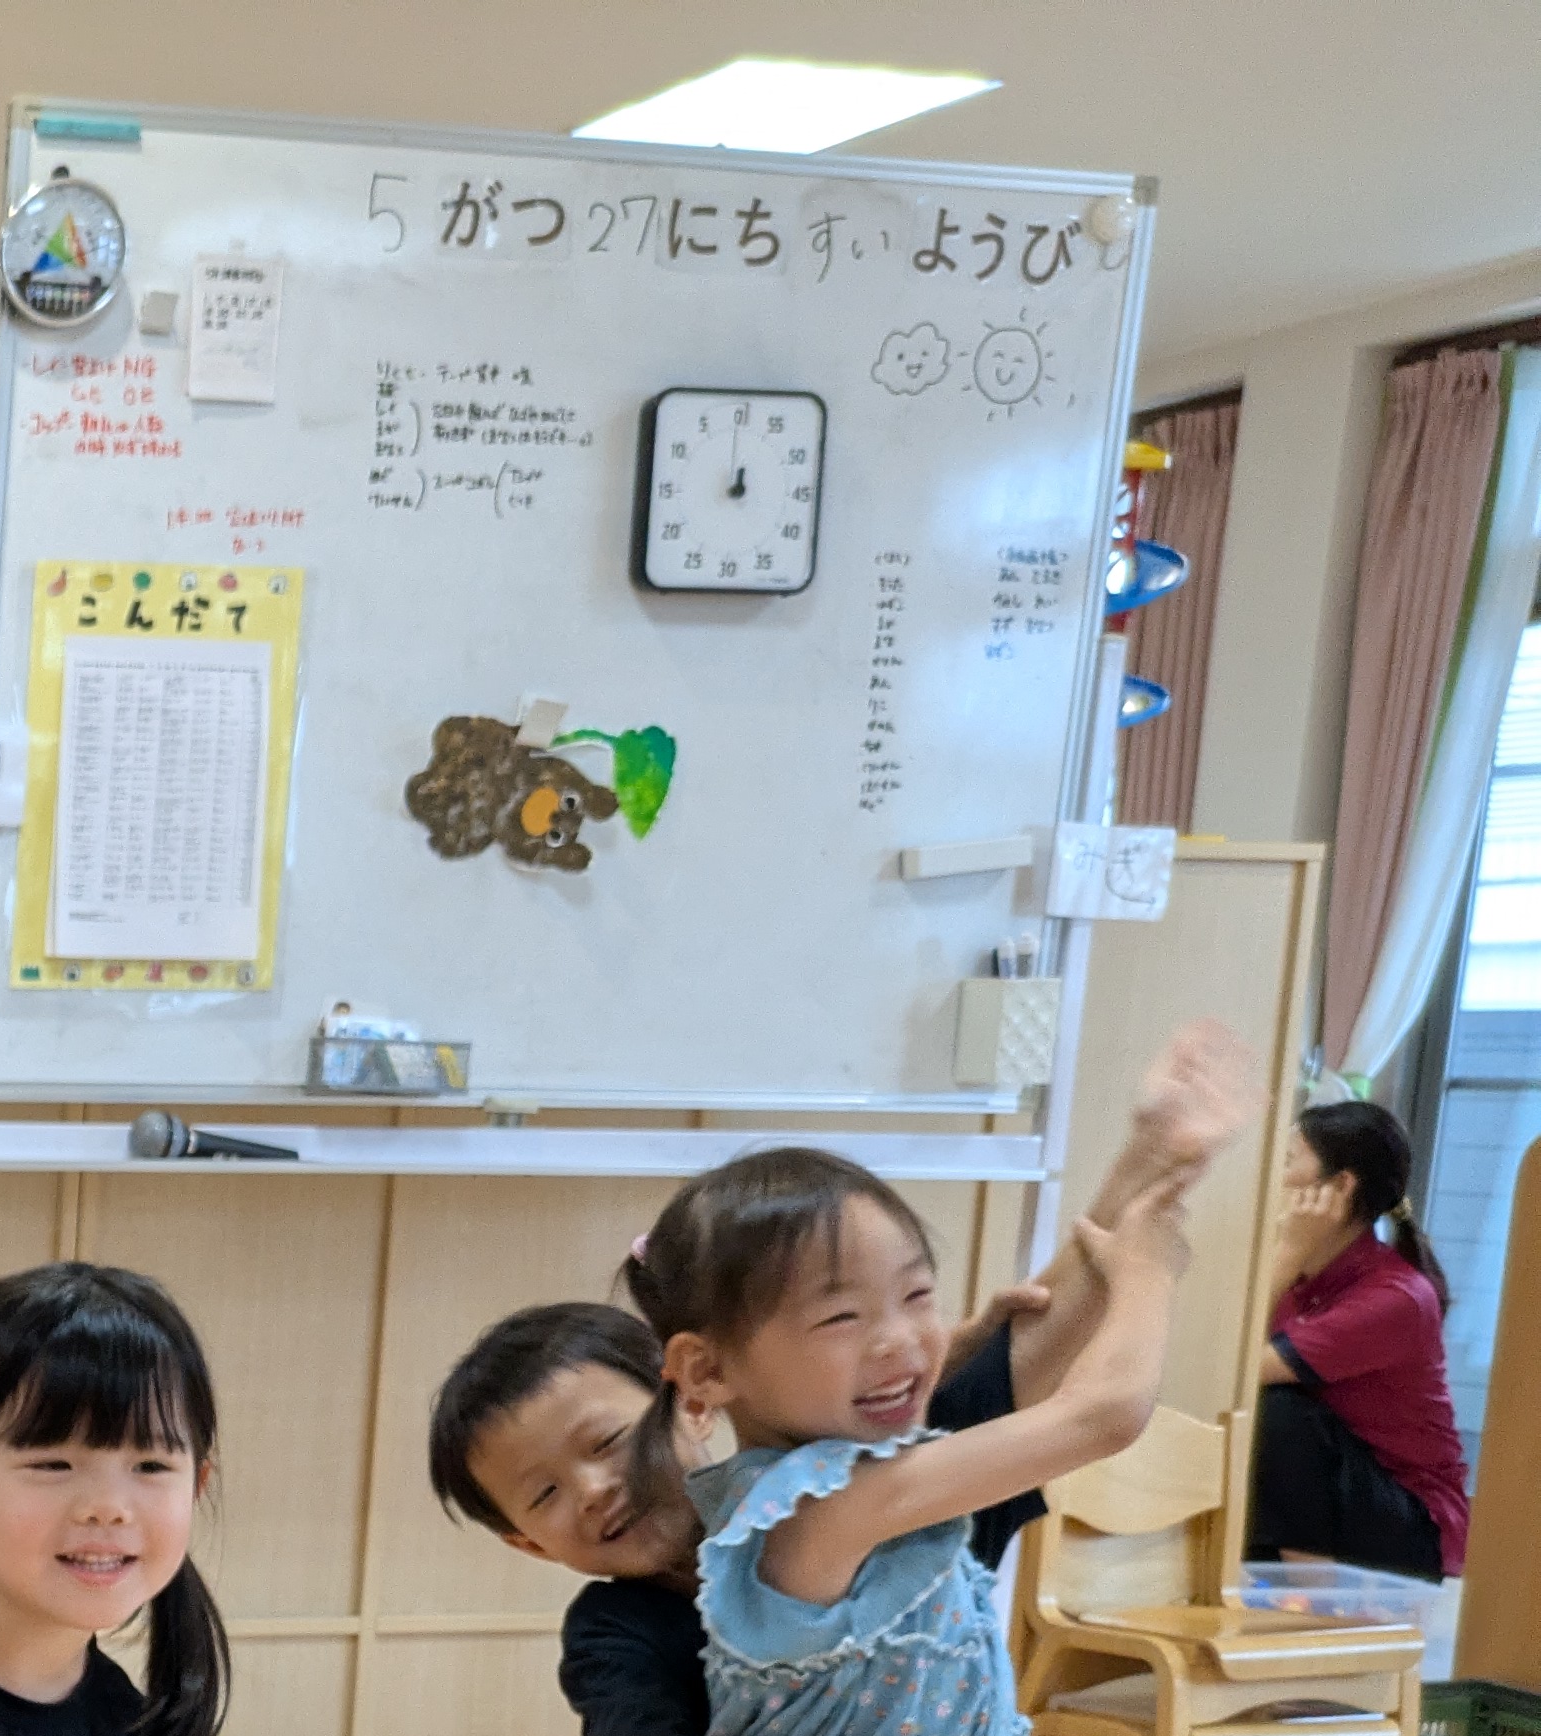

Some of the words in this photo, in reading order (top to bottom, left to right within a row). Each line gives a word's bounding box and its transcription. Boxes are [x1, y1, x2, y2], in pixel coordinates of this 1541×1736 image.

[368, 171, 408, 253] 5
[440, 179, 566, 247] がつ
[588, 194, 658, 255] 27
[667, 197, 780, 267] にち
[807, 211, 890, 284] すい
[912, 207, 1081, 286] ようび
[781, 523, 800, 541] 40
[718, 561, 737, 579] 30
[77, 596, 248, 633] こんだて
